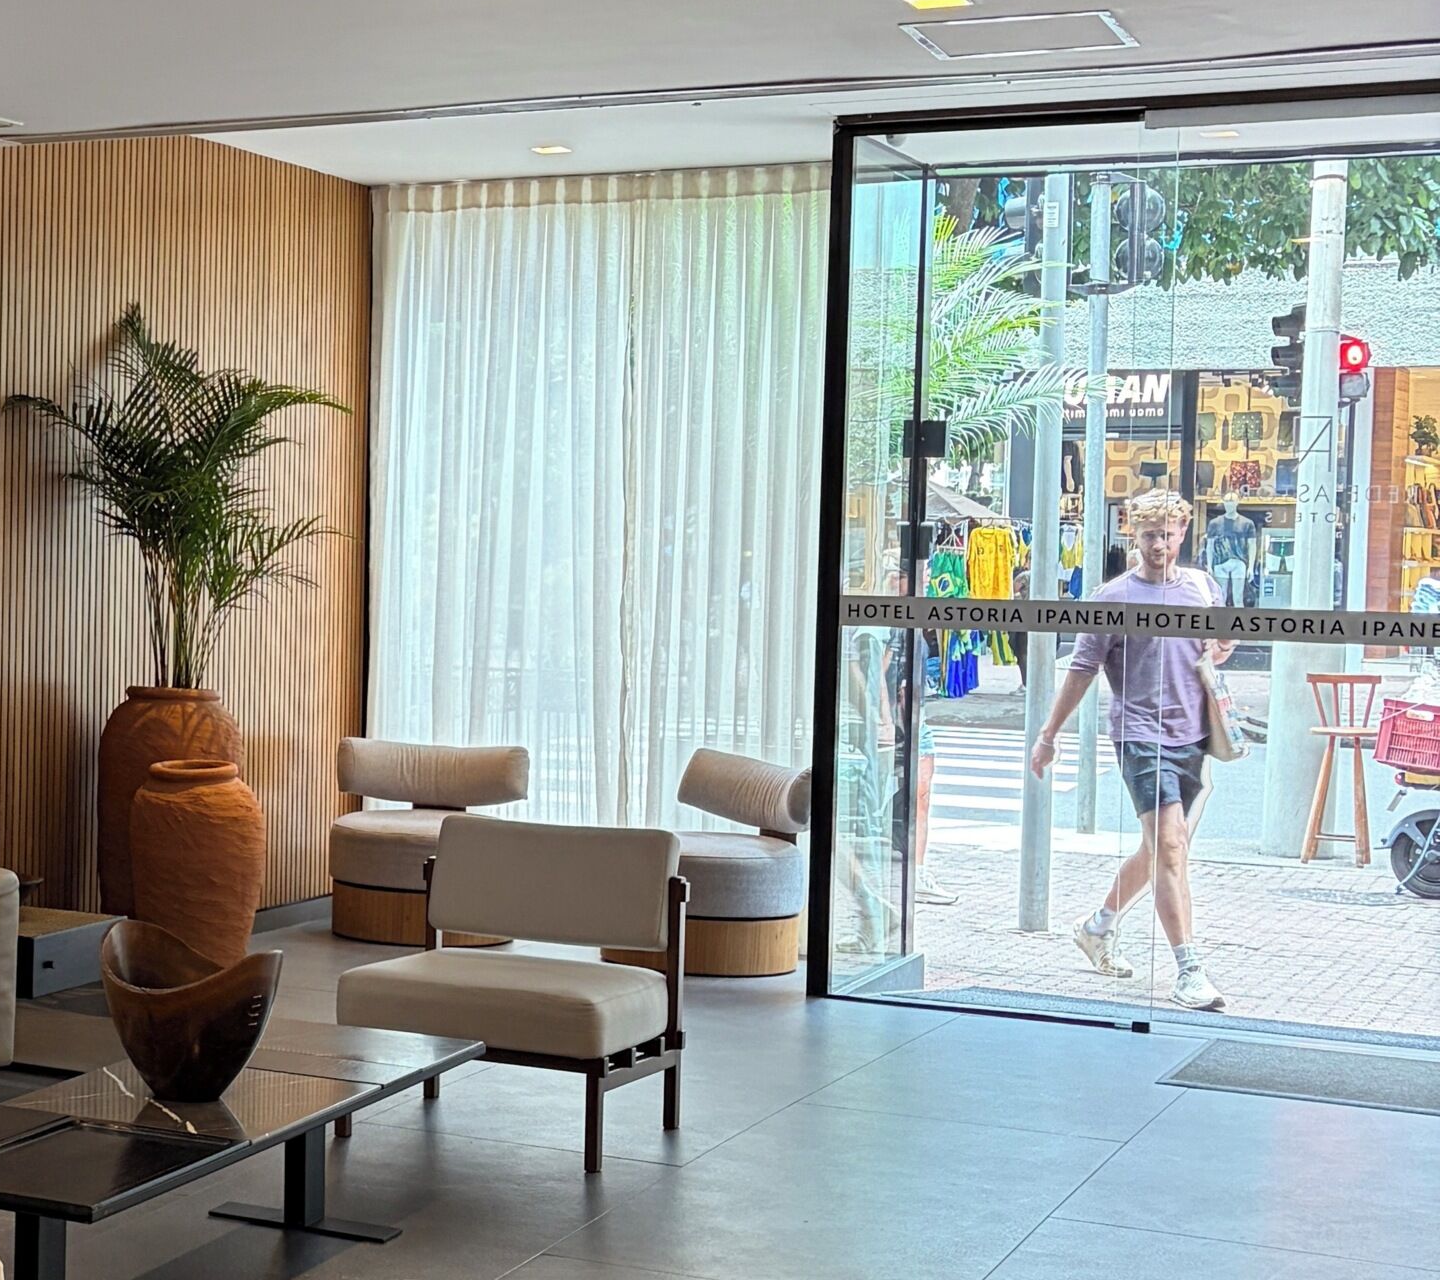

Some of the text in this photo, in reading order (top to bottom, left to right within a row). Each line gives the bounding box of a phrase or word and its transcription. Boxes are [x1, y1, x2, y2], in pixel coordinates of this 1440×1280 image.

[1129, 407, 1164, 417] uomo
[848, 603, 1124, 626] HOTEL ASTORIA IPANEM
[1136, 612, 1215, 630] HOTEL
[1231, 615, 1344, 635] ASTORIA
